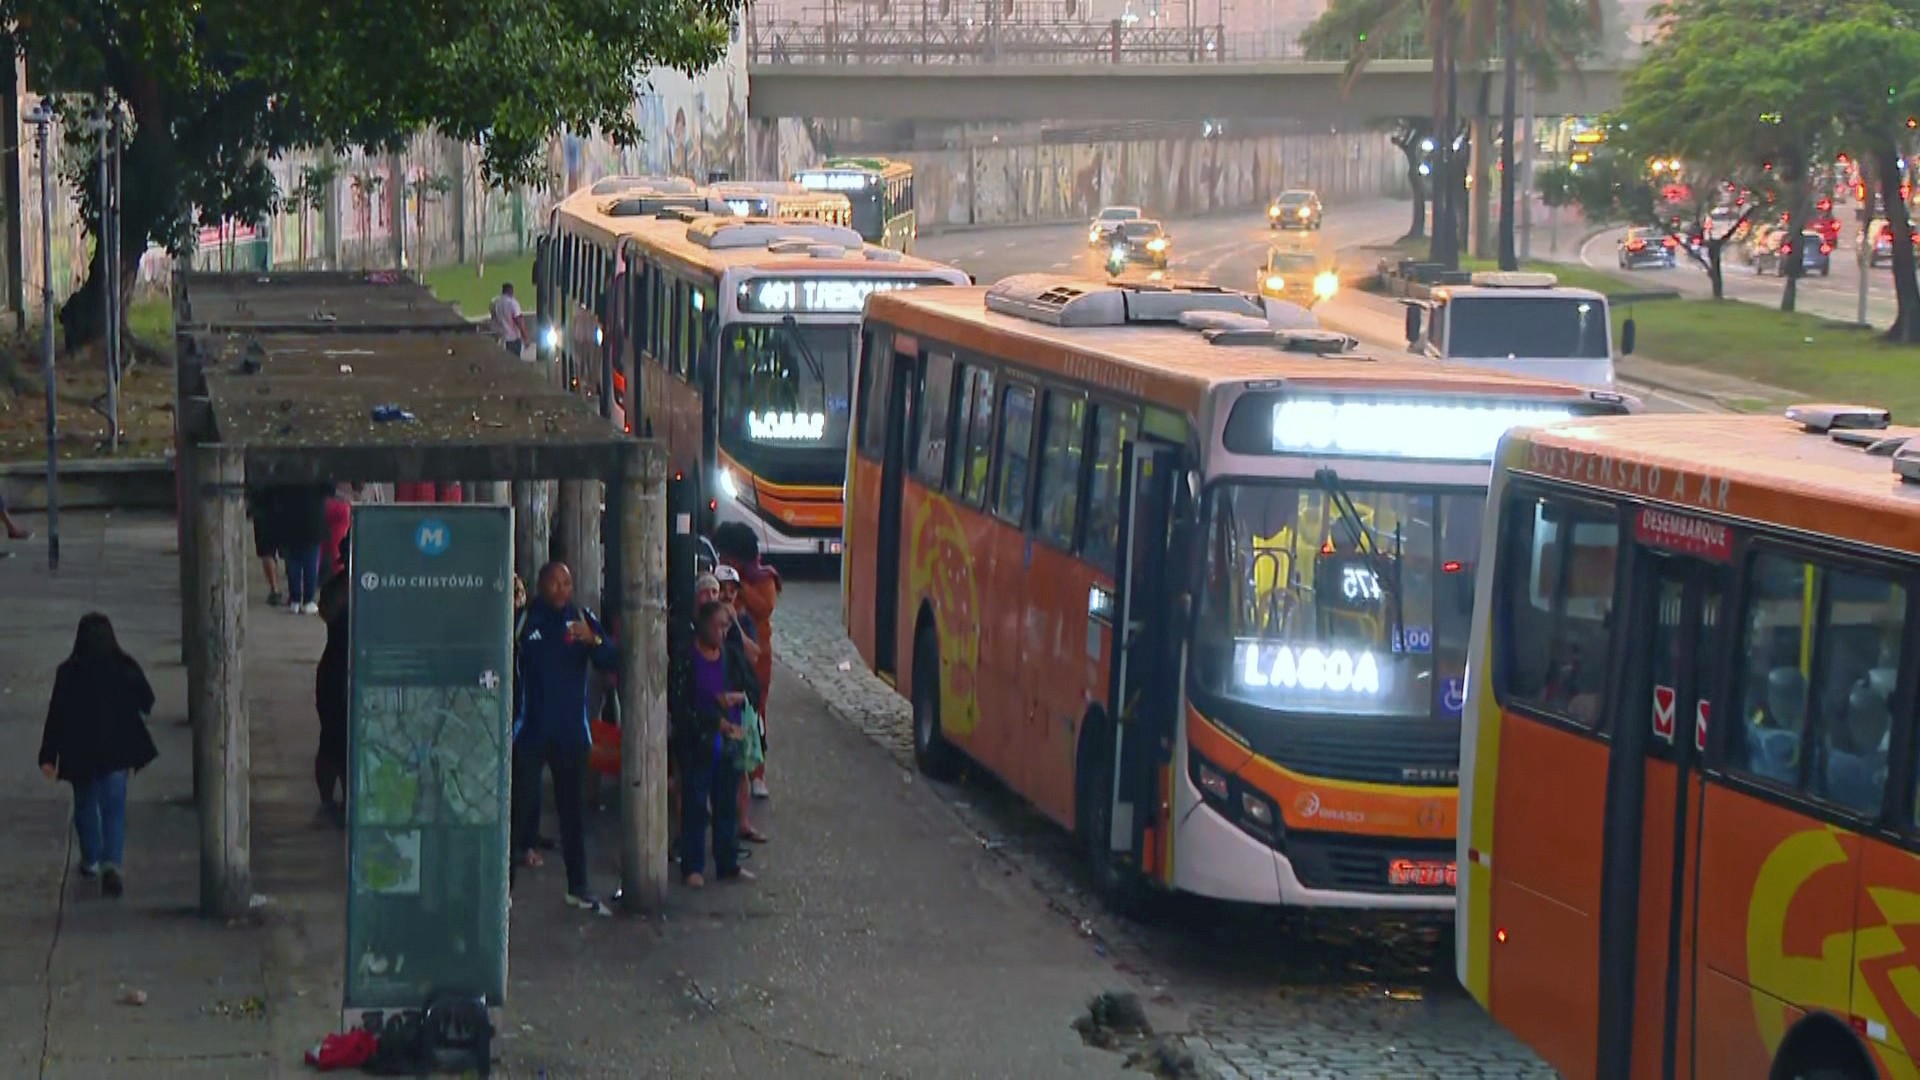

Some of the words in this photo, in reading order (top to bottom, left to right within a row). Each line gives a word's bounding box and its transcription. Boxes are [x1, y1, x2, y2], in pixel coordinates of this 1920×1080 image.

[1672, 470, 1686, 500] A
[1698, 475, 1732, 510] AR
[420, 527, 444, 548] M
[1642, 508, 1727, 546] DESEMBARQUE
[380, 573, 406, 588] SÃO
[410, 573, 484, 588] CRISTÓVÃO
[1245, 642, 1379, 694] LAGOA
